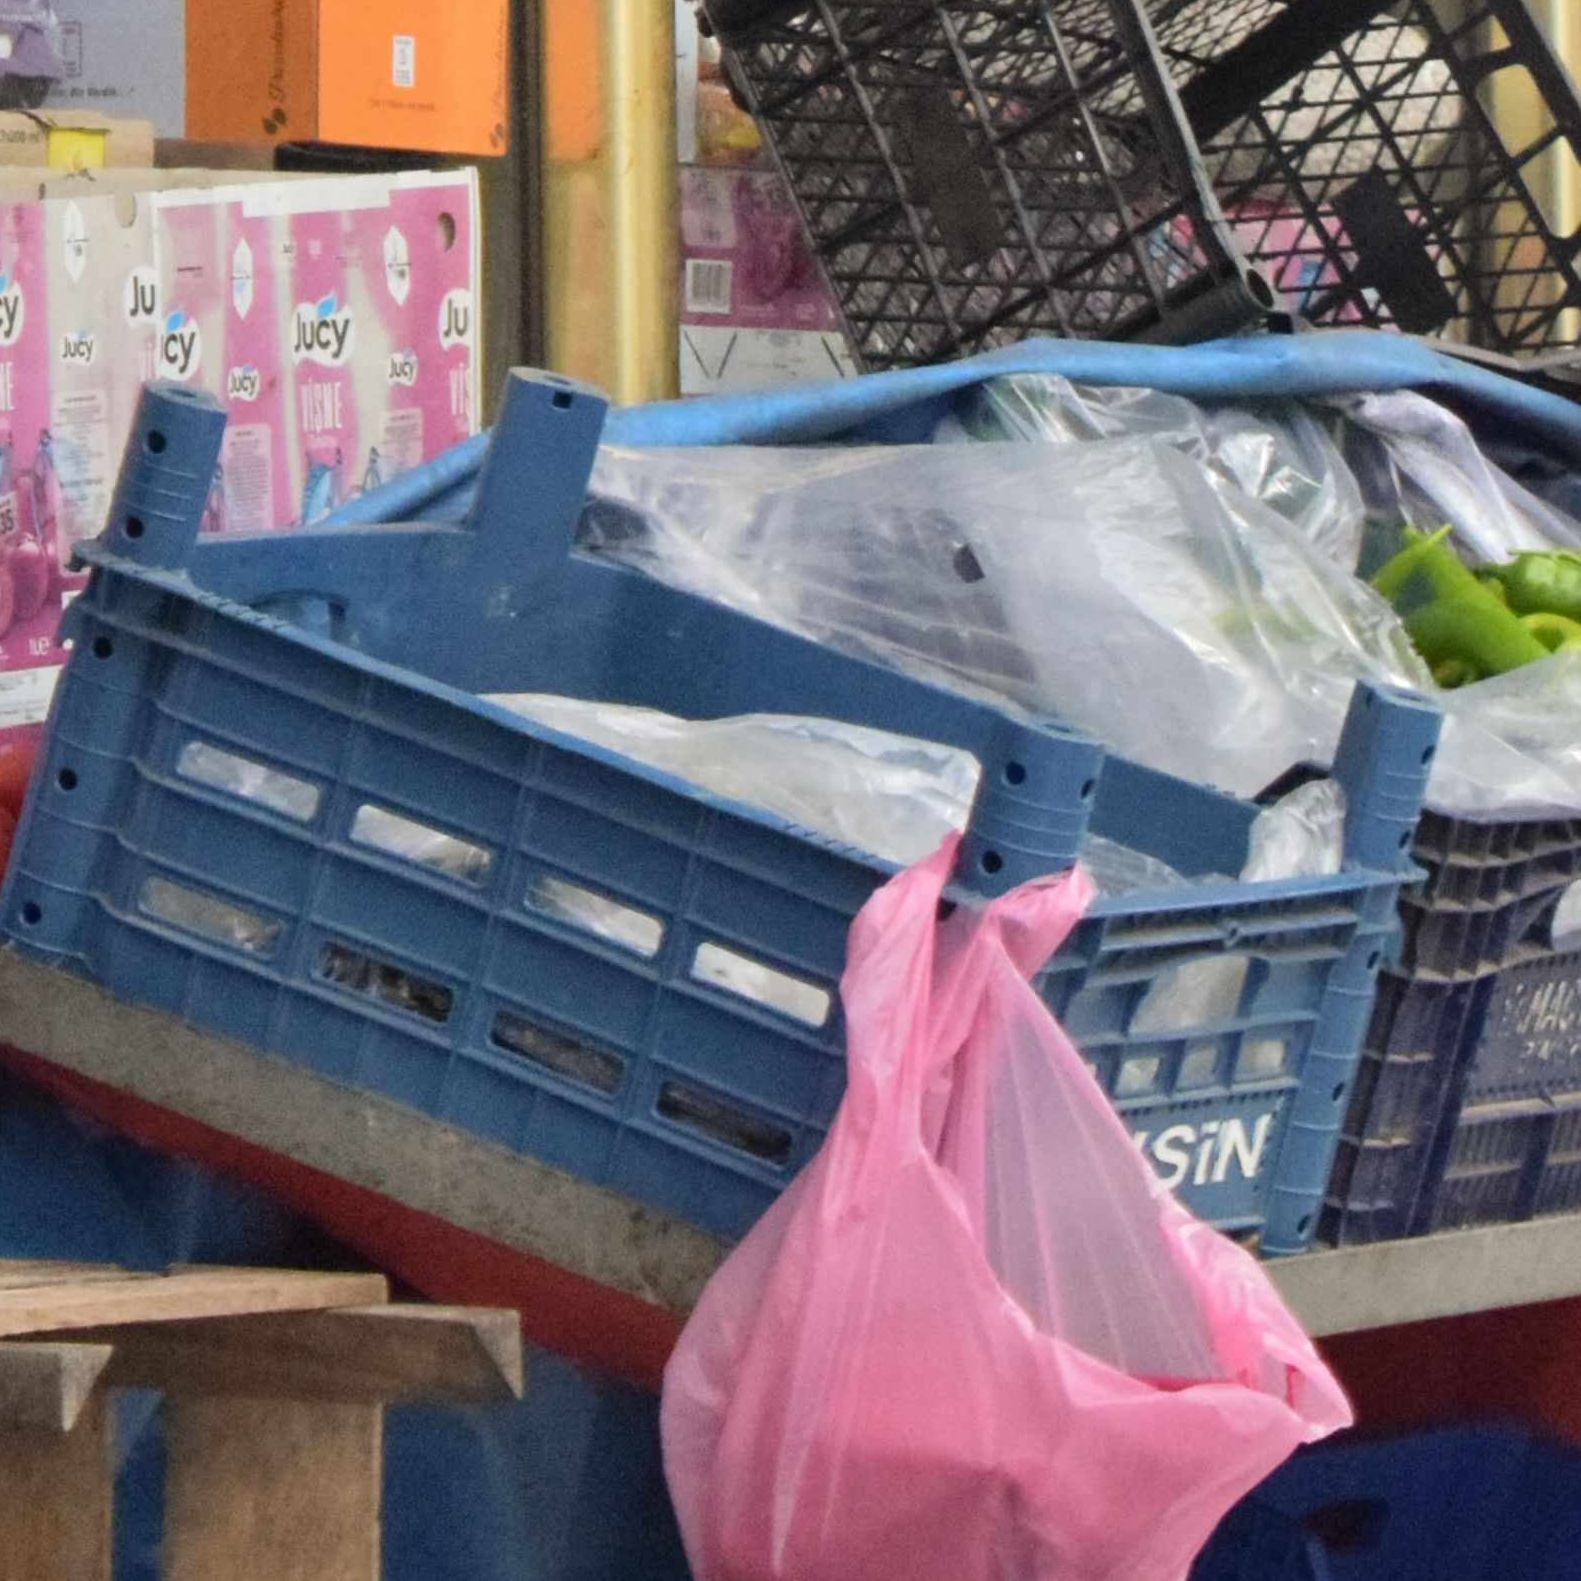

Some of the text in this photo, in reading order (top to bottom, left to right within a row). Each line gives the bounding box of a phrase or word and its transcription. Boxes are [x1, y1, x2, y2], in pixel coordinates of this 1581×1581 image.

[62, 335, 94, 361] Jucy
[294, 312, 349, 358] Jucy
[389, 355, 415, 381] Jucy
[228, 372, 258, 398] Jucy
